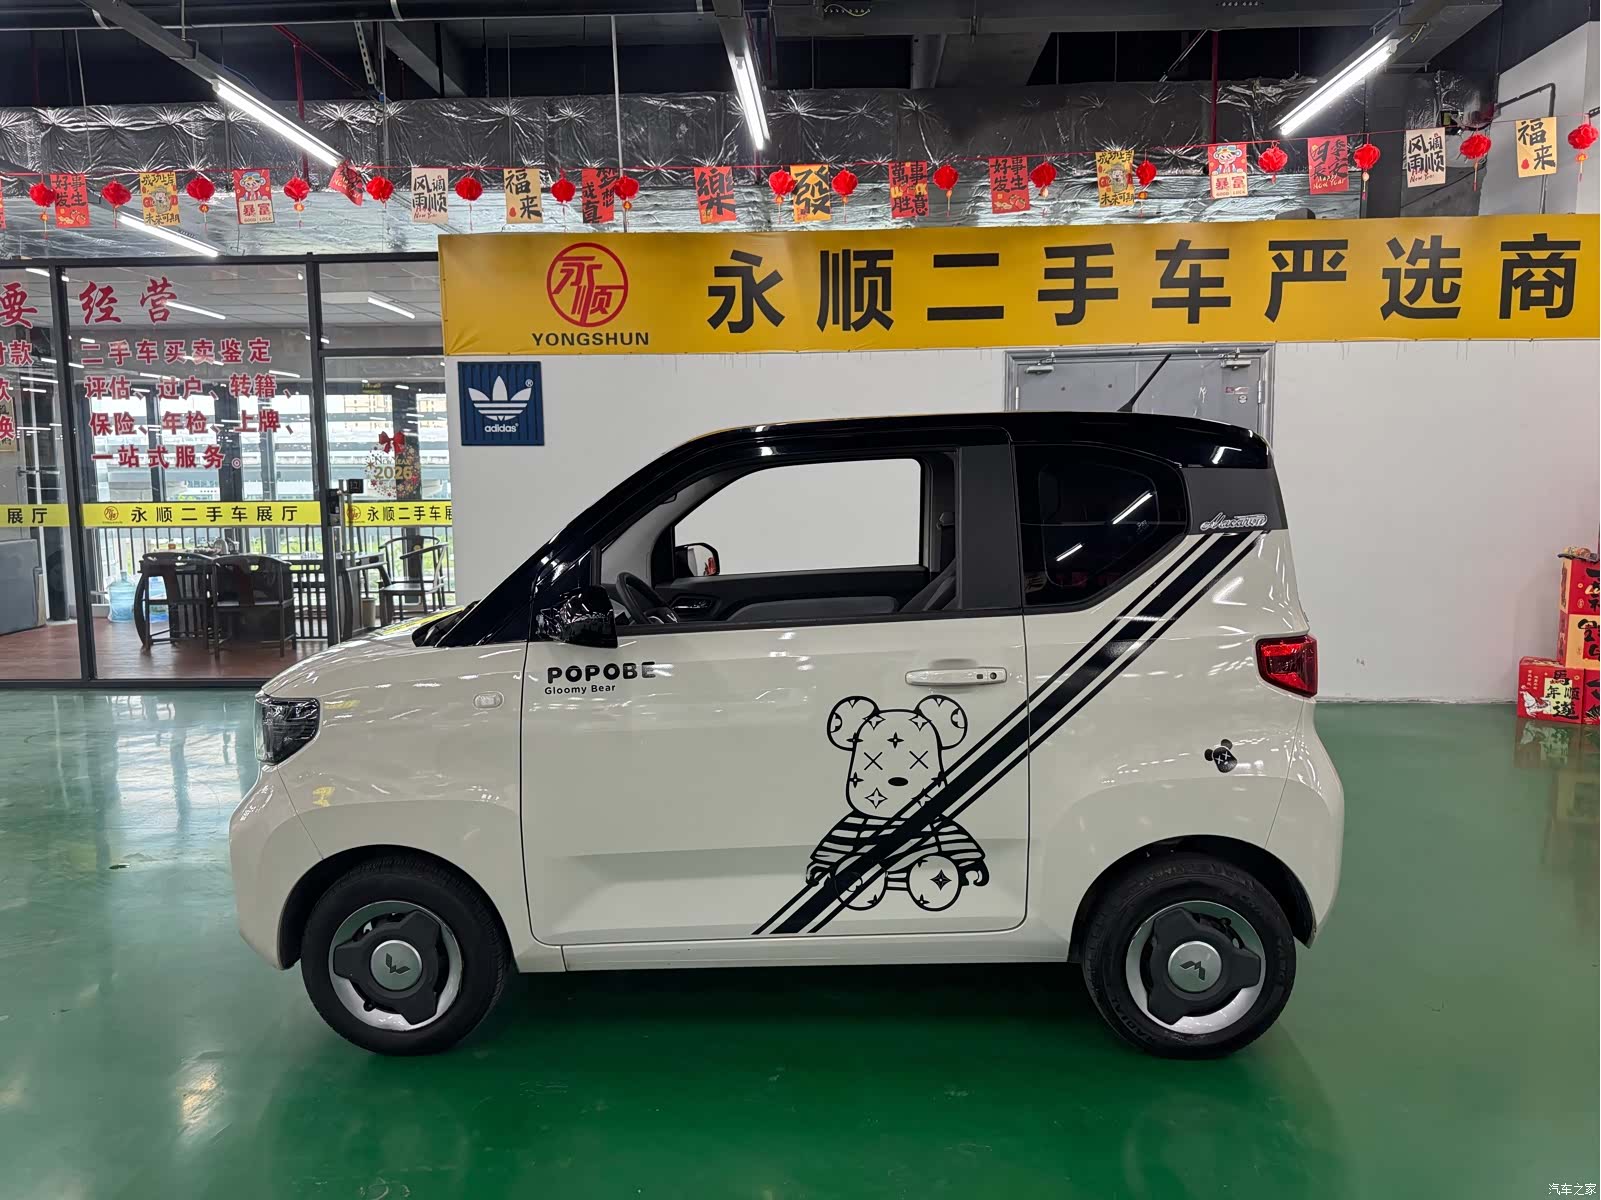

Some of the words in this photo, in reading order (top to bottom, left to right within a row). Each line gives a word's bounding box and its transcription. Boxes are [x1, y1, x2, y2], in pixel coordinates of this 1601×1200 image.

[1408, 134, 1443, 155] 风调
[1518, 119, 1556, 171] 福来
[1097, 150, 1133, 164] 成功上岸
[1408, 151, 1444, 172] 雨顺
[990, 157, 1026, 175] 好事
[52, 175, 85, 190] 好事
[141, 173, 175, 186] 成功上岸
[413, 174, 446, 193] 风调
[993, 175, 1027, 192] 发生
[1216, 175, 1245, 189] 暴富
[505, 168, 542, 220] 福来
[697, 168, 736, 216] 樂
[791, 165, 831, 215] 發
[1100, 191, 1134, 206] 未来可期
[56, 192, 87, 208] 发生
[412, 192, 447, 213] 雨顺
[243, 204, 271, 216] 暴富
[145, 213, 180, 225] 未来可期
[707, 232, 1582, 335] 永顺二手车严选商
[532, 332, 650, 347] YONGSHUN
[81, 337, 272, 366] 二手车买卖鉴定
[484, 424, 517, 433] adidas
[92, 445, 242, 470] 一站式服务。
[374, 466, 413, 480] 2026
[8, 508, 48, 525] 展厅
[130, 505, 298, 524] 永顺二手车展厅
[547, 661, 656, 684] POPOBE
[544, 686, 587, 696] Gloomy
[591, 684, 616, 693] Bear
